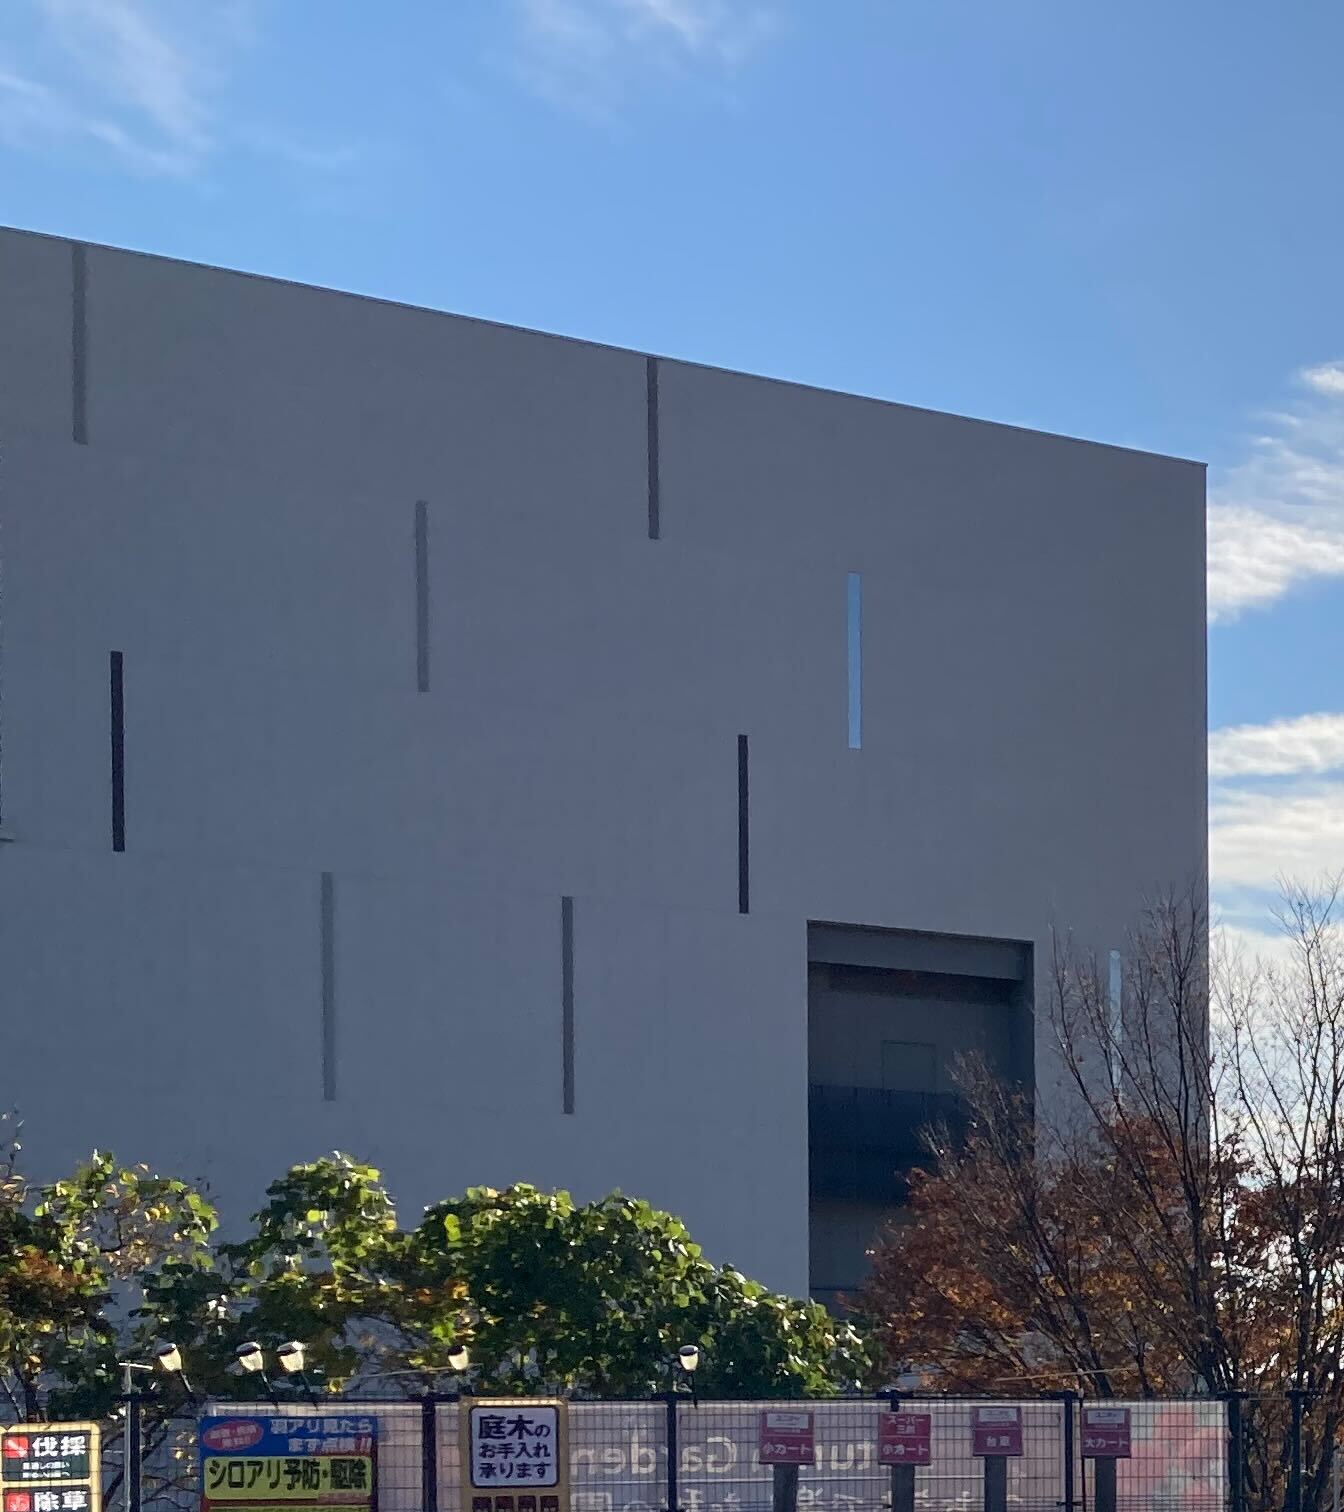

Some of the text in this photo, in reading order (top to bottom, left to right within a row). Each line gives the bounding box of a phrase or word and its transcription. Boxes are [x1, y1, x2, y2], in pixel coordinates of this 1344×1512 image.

[478, 1414, 551, 1440] 庭木の
[32, 1435, 86, 1457] 伐採
[479, 1442, 551, 1460] お手入れ
[208, 1458, 367, 1491] シロアリ予防・駆除
[479, 1461, 552, 1479] 承ります
[33, 1490, 88, 1512] 除草
